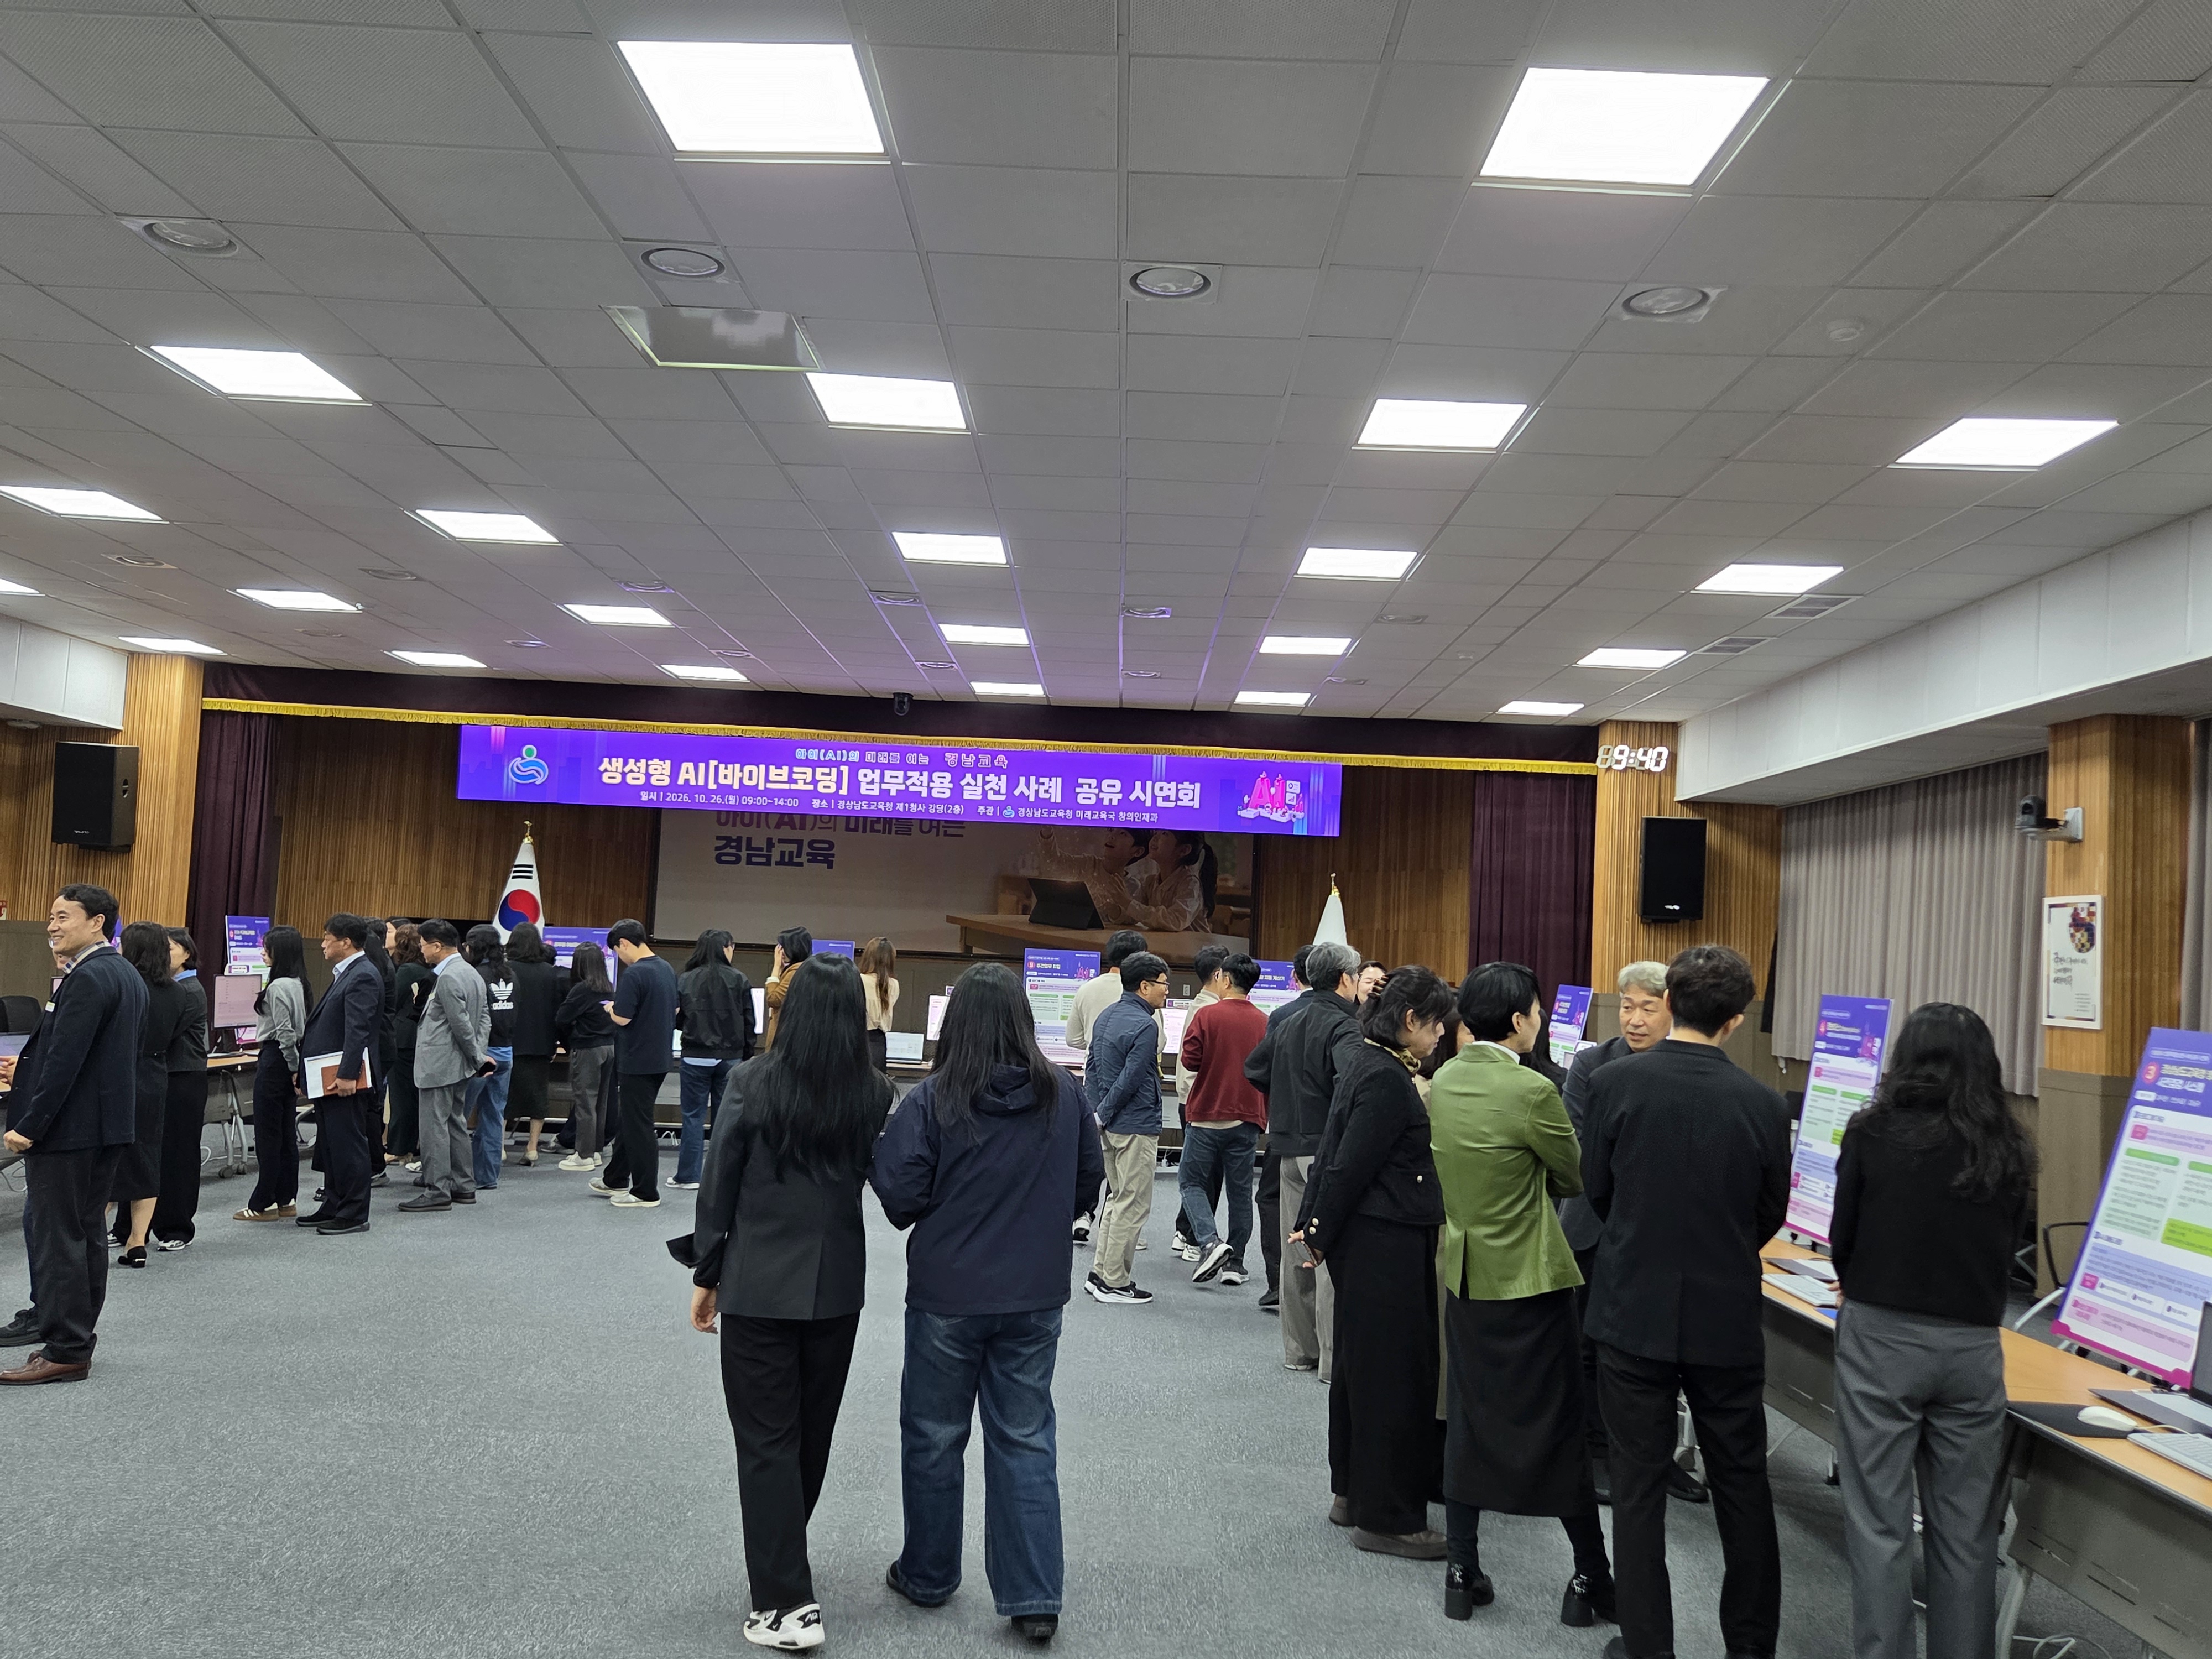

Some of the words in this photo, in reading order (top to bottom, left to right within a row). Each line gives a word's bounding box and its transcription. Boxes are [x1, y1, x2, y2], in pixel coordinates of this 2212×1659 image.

[795, 748, 859, 763] 아이(AI)의
[865, 751, 900, 764] 미래를
[905, 753, 929, 765] 여는
[944, 752, 1008, 769] 경남교육
[598, 757, 671, 786] 생성형
[677, 759, 849, 795] AI[바이브코딩]
[858, 768, 953, 799] 업무적용
[959, 773, 1007, 801] 실천
[1013, 775, 1062, 803] 사례
[1075, 777, 1123, 806] 공유
[1128, 780, 1201, 809] 시연회
[640, 791, 657, 802] 일시
[665, 792, 691, 802] 2026.
[693, 794, 708, 804] 10.
[742, 795, 799, 807] 09:00~14:00
[1248, 777, 1286, 810] AI
[811, 799, 828, 809] 장소
[837, 800, 894, 812] 경상남도교육청
[895, 802, 926, 813] 제1청사
[977, 805, 994, 816] 주관
[1018, 808, 1073, 819] 경상남도교육청
[1076, 810, 1116, 821] 미래교육국
[1118, 811, 1159, 823] 창의인재과
[714, 834, 836, 870] 경남교육
[493, 1000, 514, 1010] adidas
